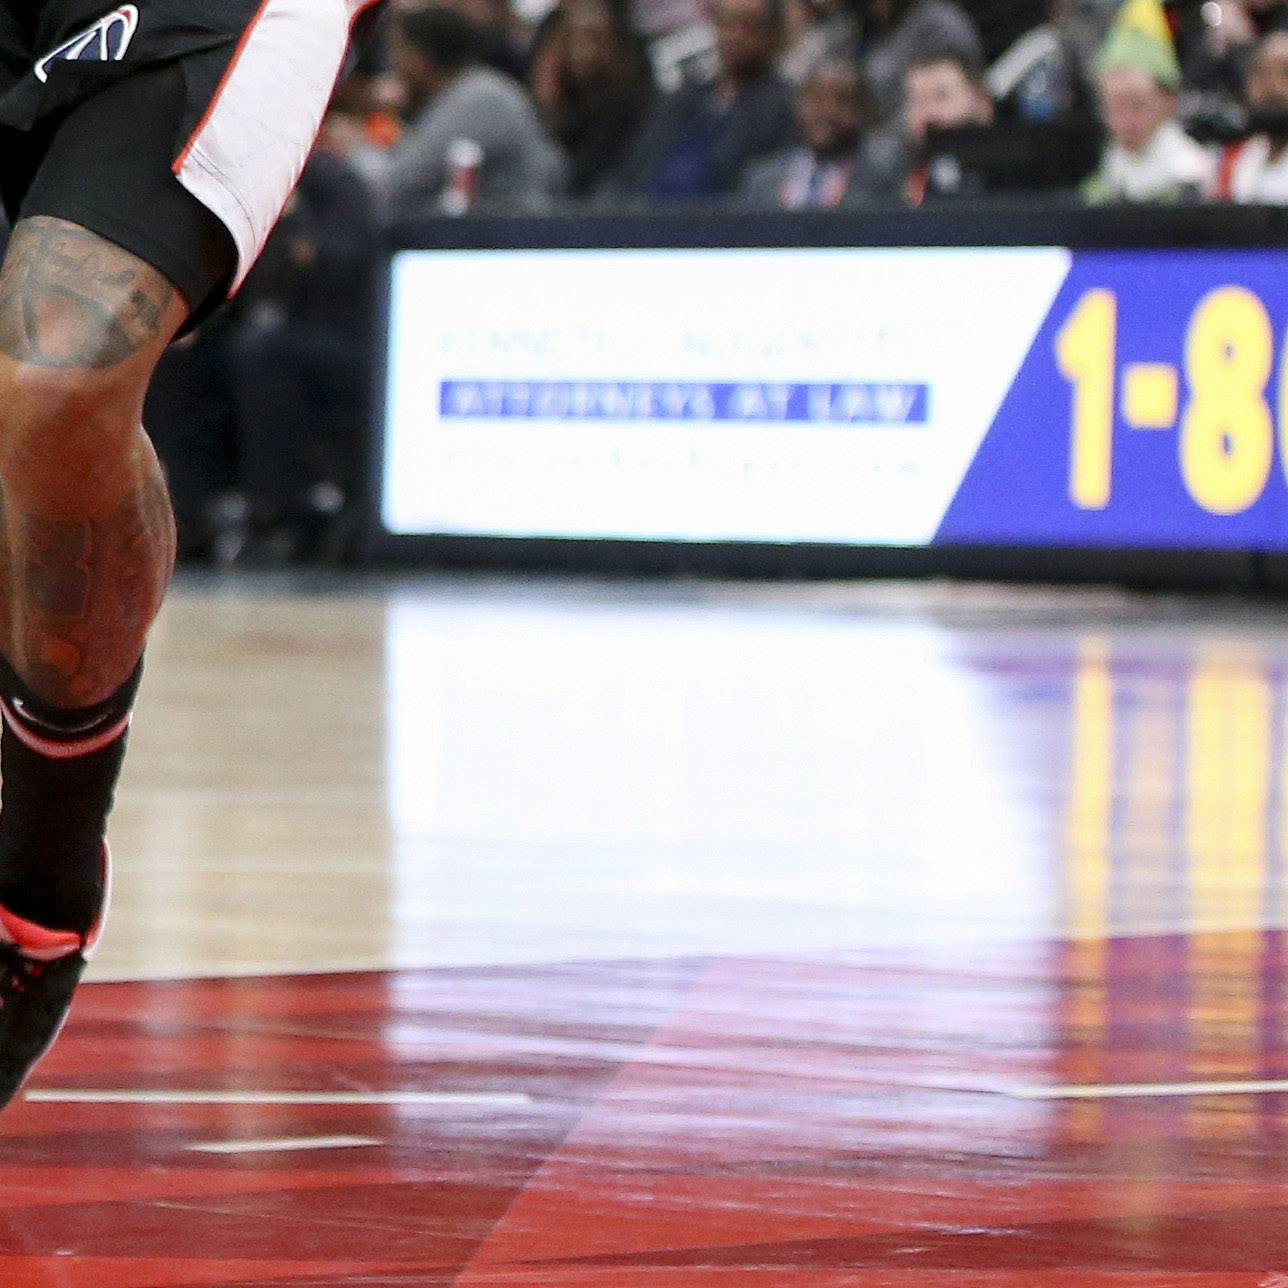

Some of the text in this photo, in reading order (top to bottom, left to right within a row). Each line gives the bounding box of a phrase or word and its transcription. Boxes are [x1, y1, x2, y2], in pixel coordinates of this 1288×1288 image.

[726, 382, 789, 420] AT
[808, 383, 916, 421] LAW
[1054, 283, 1288, 517] 1-8
